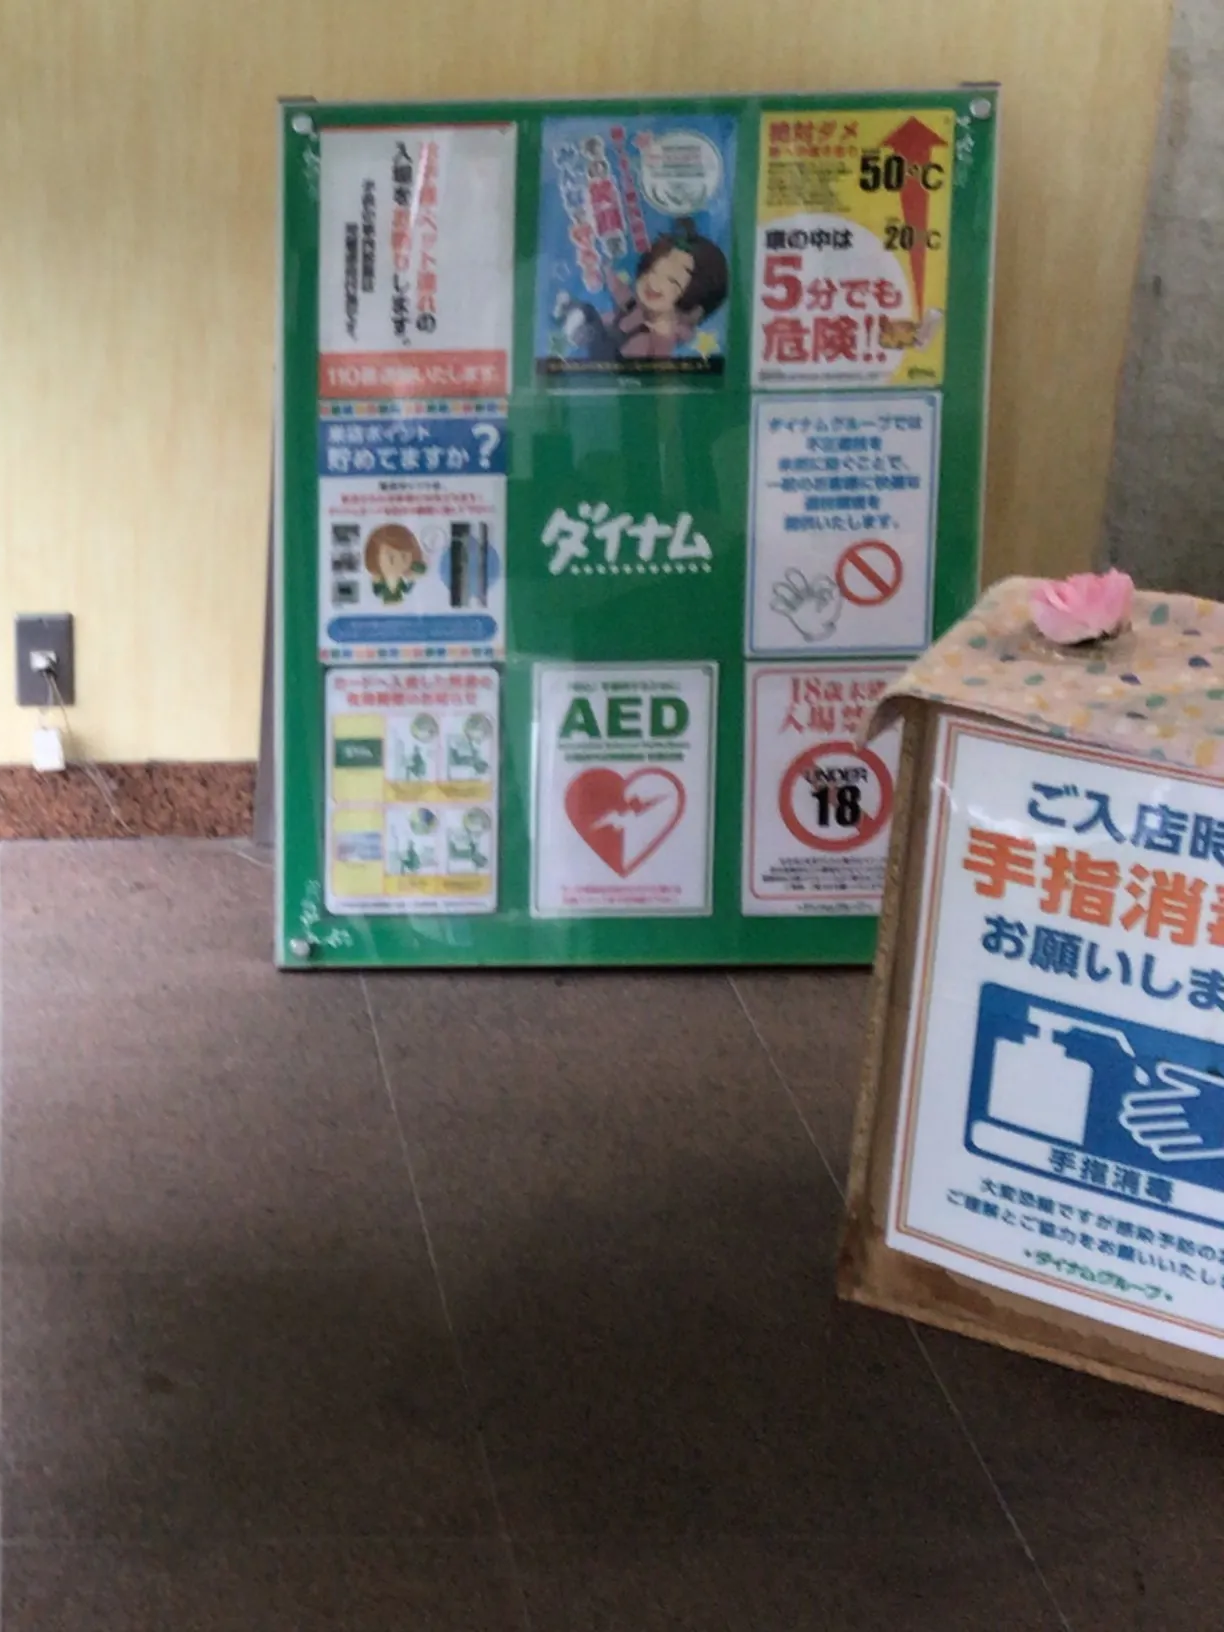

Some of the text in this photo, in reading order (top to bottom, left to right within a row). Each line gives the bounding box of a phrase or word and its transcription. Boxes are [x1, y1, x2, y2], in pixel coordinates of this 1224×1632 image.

[765, 228, 854, 250] 車の中は
[760, 254, 904, 312] 5分でも
[541, 501, 713, 575] ダイナム
[560, 696, 690, 738] AED
[811, 784, 862, 829] 18
[962, 826, 1224, 948] 手指消
[980, 914, 1224, 1011] お願いしま
[1048, 1147, 1174, 1204] 手指消毒
[946, 1188, 1224, 1290] ご理解とご協力をお願いいたし
[980, 1176, 1224, 1266] 大変恐縮ですが感染予防の
